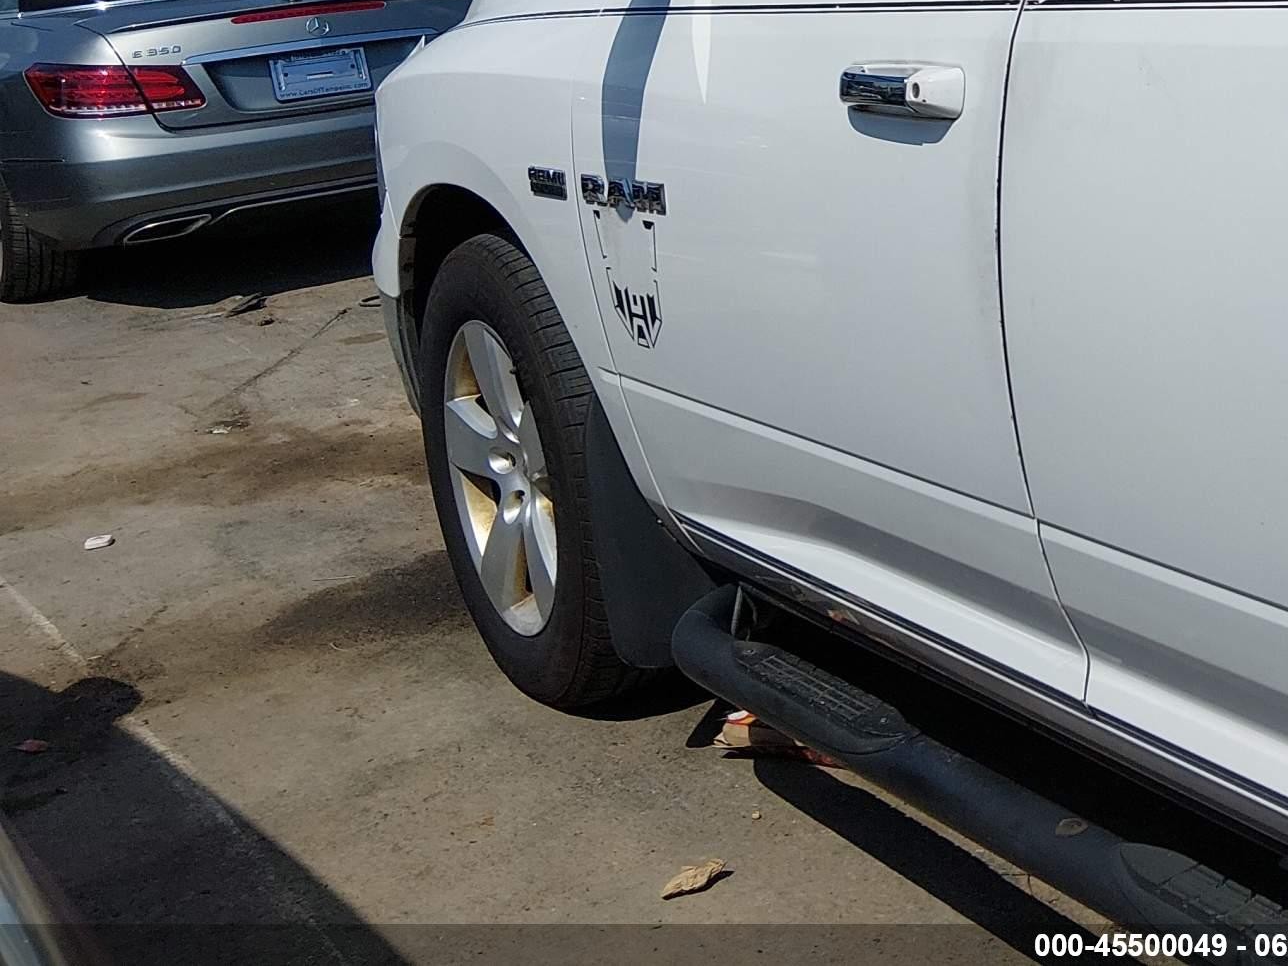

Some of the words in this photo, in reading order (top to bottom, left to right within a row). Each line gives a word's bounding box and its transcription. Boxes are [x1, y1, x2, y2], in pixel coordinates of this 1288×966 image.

[132, 50, 143, 58] E
[145, 45, 182, 57] 350
[580, 173, 667, 216] RAM
